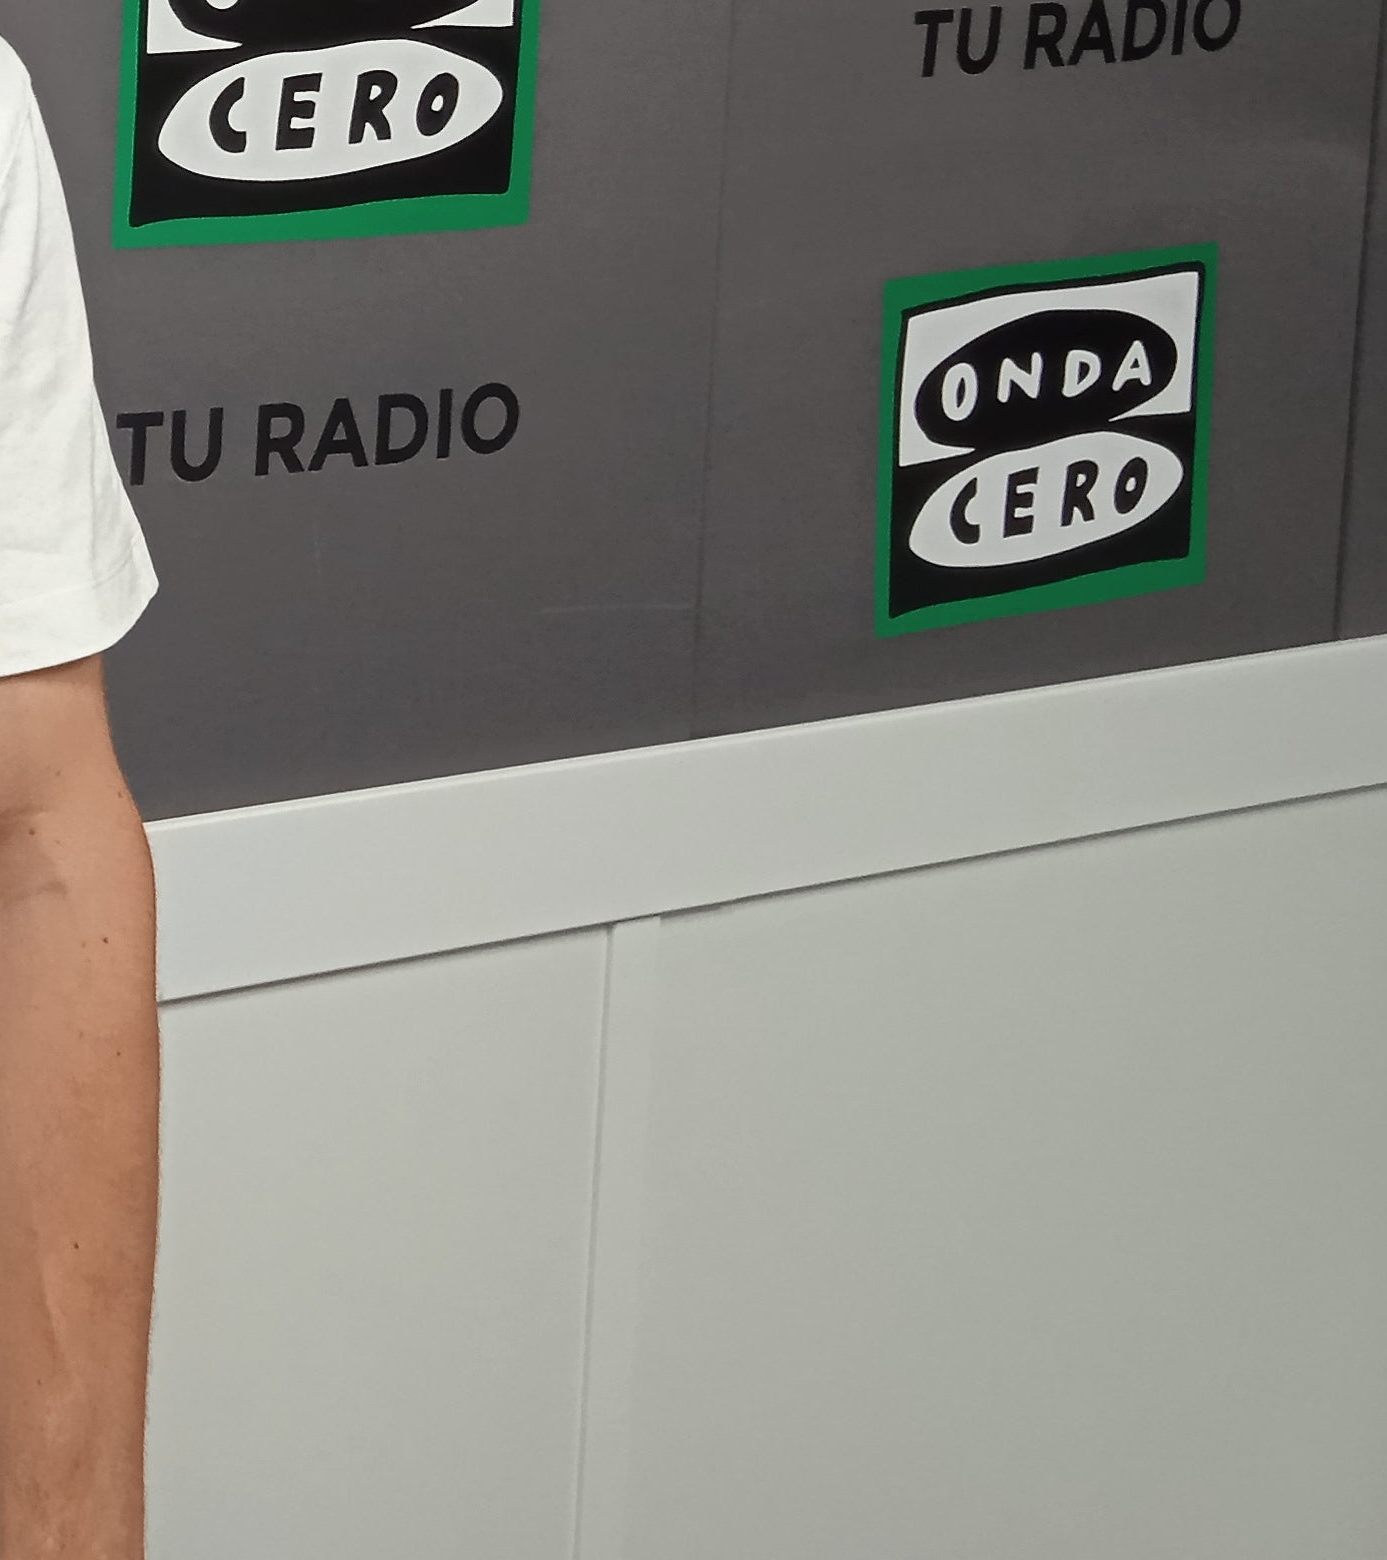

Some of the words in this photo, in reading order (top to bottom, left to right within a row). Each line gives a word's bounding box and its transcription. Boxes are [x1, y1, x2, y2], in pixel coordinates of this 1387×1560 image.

[914, 6, 1003, 77] TU
[208, 69, 460, 154] CERO
[941, 339, 1152, 422] ONDA
[116, 407, 224, 486] TU
[254, 382, 520, 477] RADIO
[949, 456, 1149, 545] CERO
